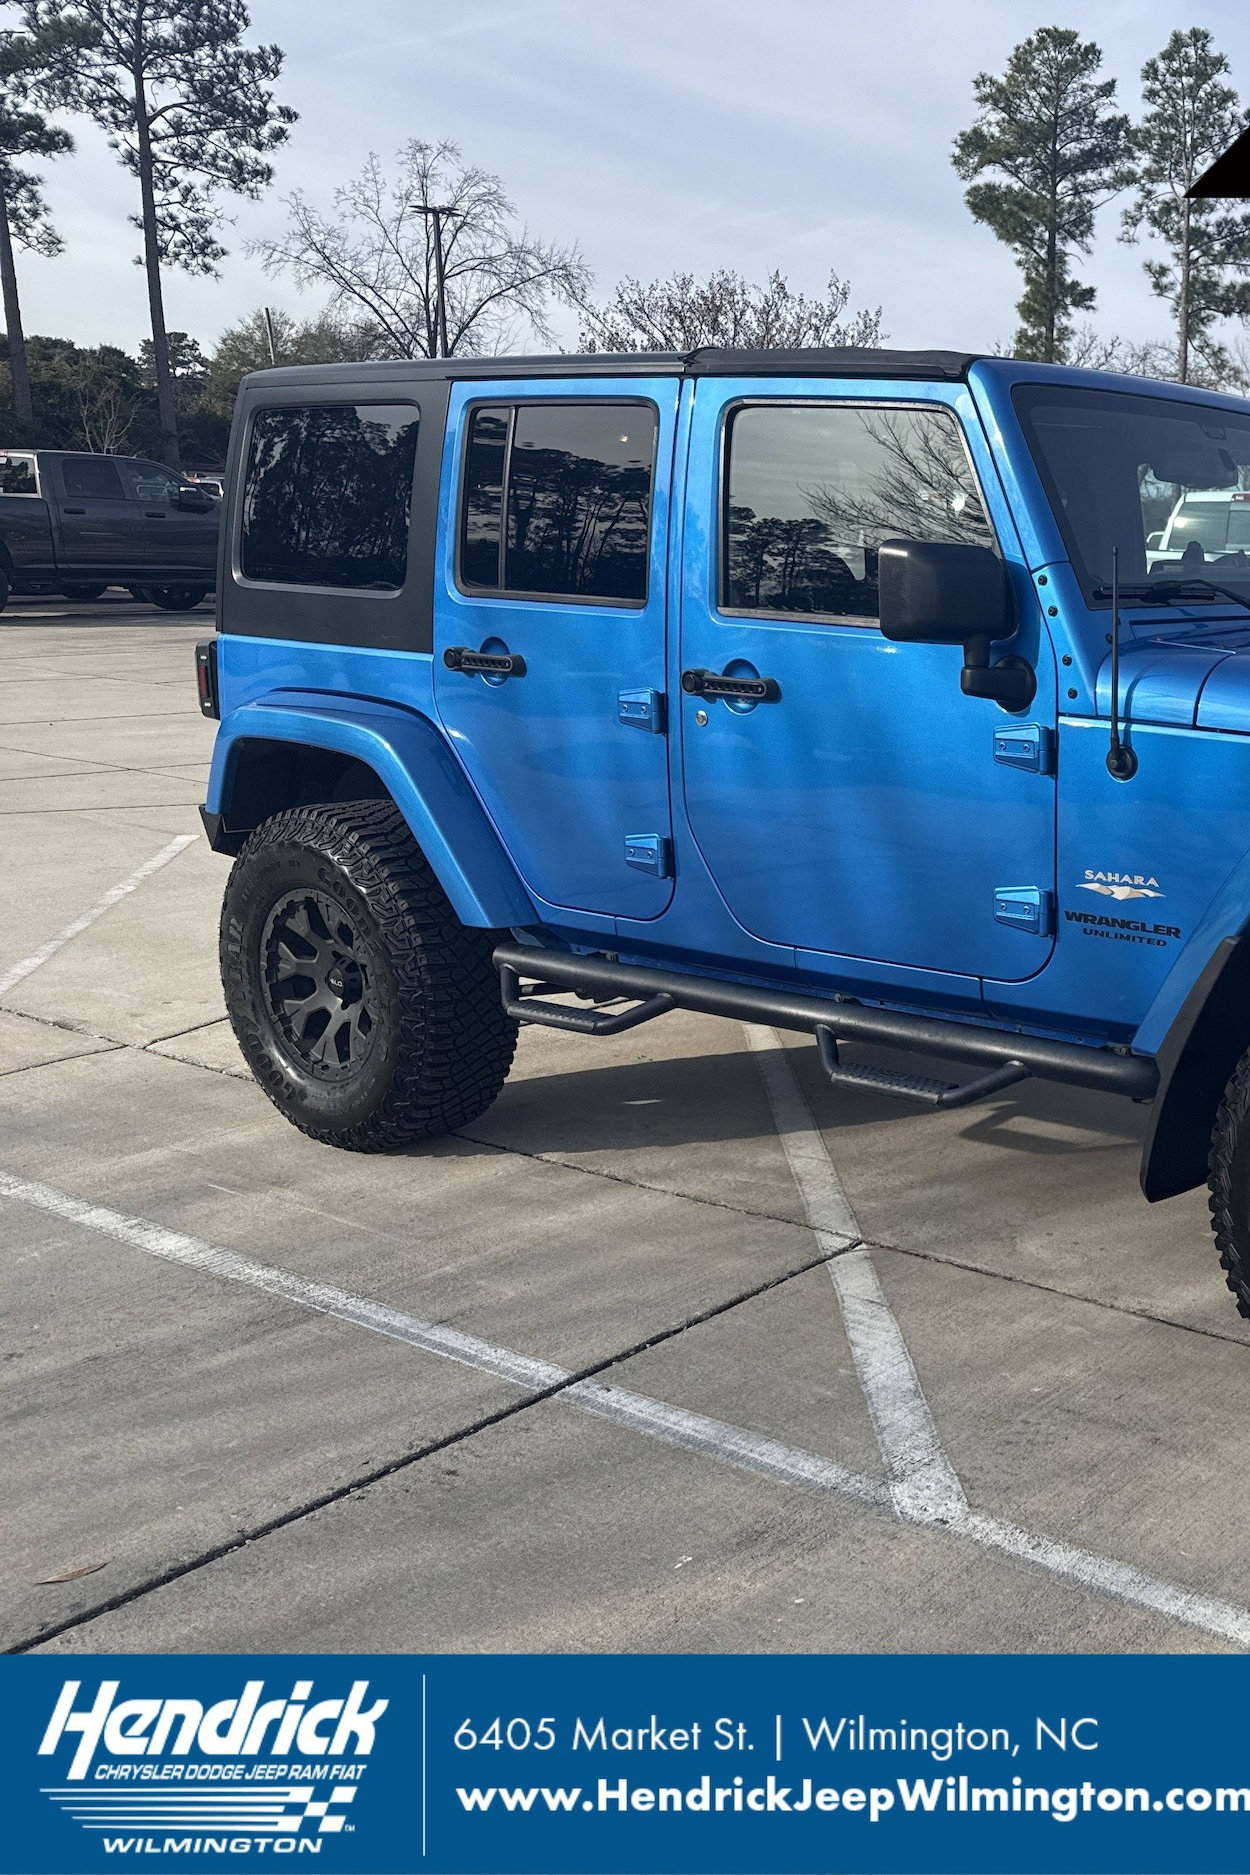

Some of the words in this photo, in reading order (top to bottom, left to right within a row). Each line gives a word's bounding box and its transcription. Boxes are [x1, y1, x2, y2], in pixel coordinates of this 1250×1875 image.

[1084, 869, 1160, 888] SAHARA
[1064, 910, 1181, 939] WRANGLER
[1083, 927, 1168, 947] UNLIMITED
